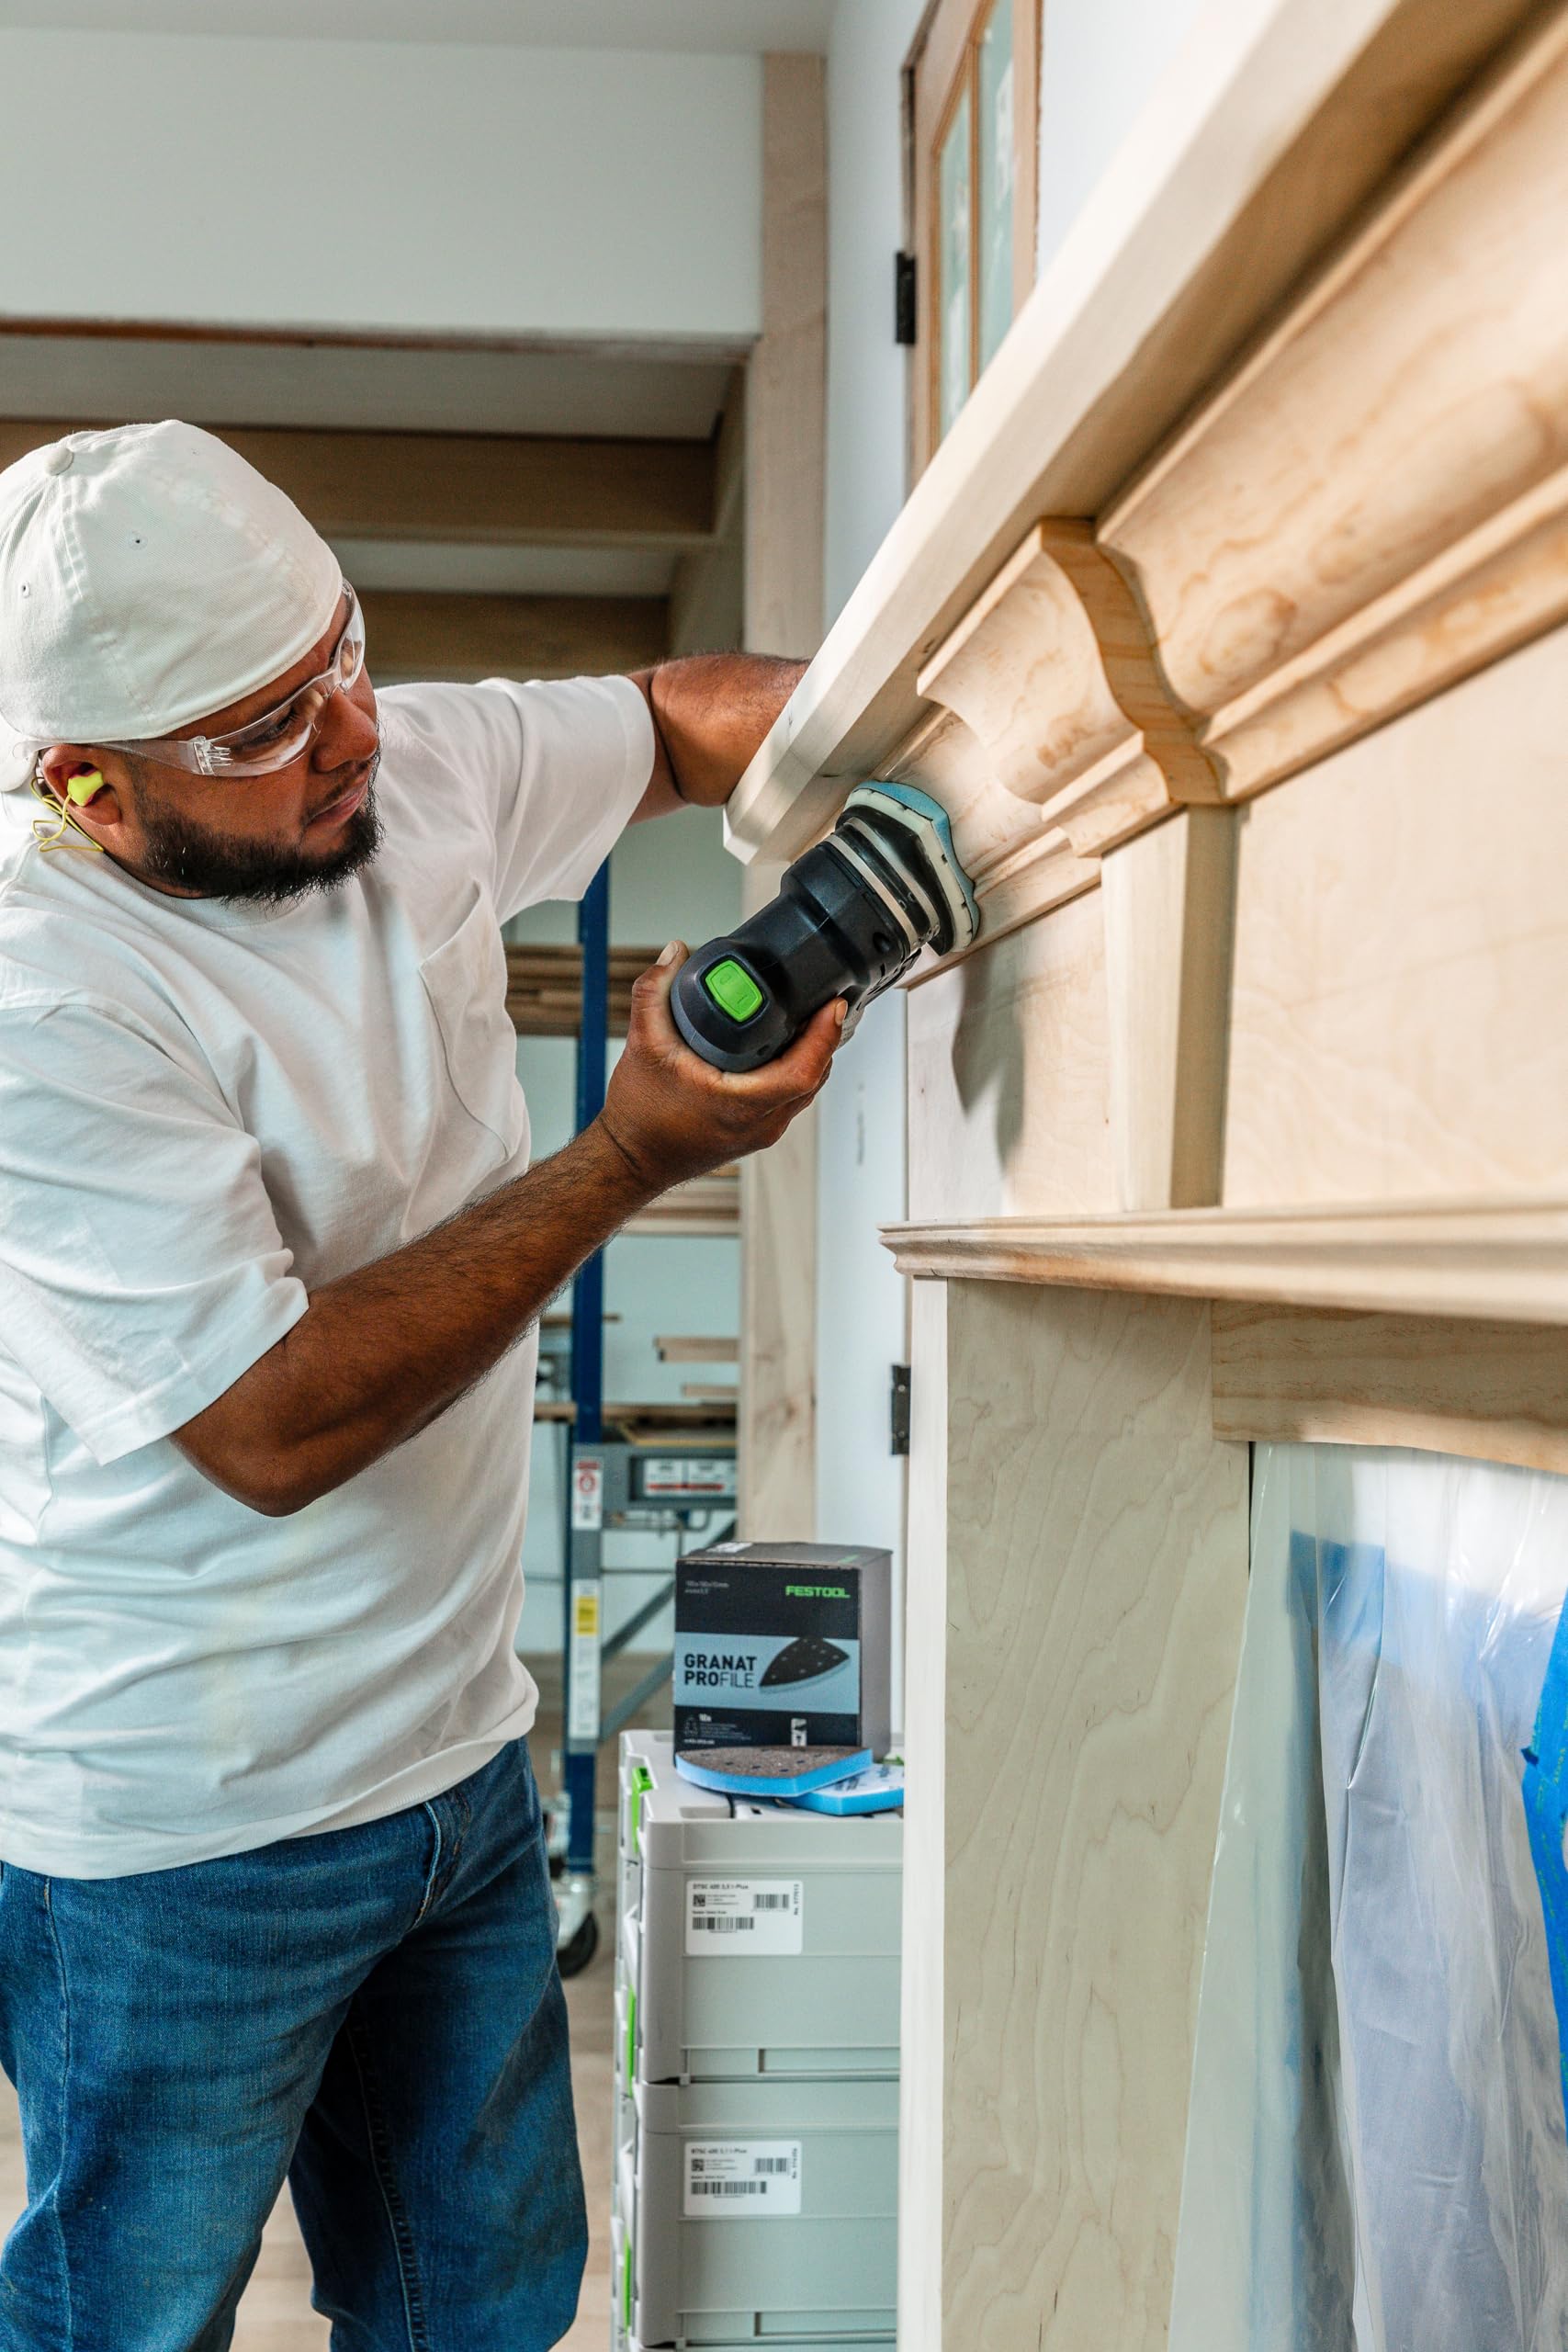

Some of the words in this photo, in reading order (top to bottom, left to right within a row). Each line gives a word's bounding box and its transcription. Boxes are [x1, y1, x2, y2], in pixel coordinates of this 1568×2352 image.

[785, 1585, 851, 1599] FESTOOL
[684, 1653, 757, 1671] GRANAT
[684, 1669, 754, 1689] PROFILE
